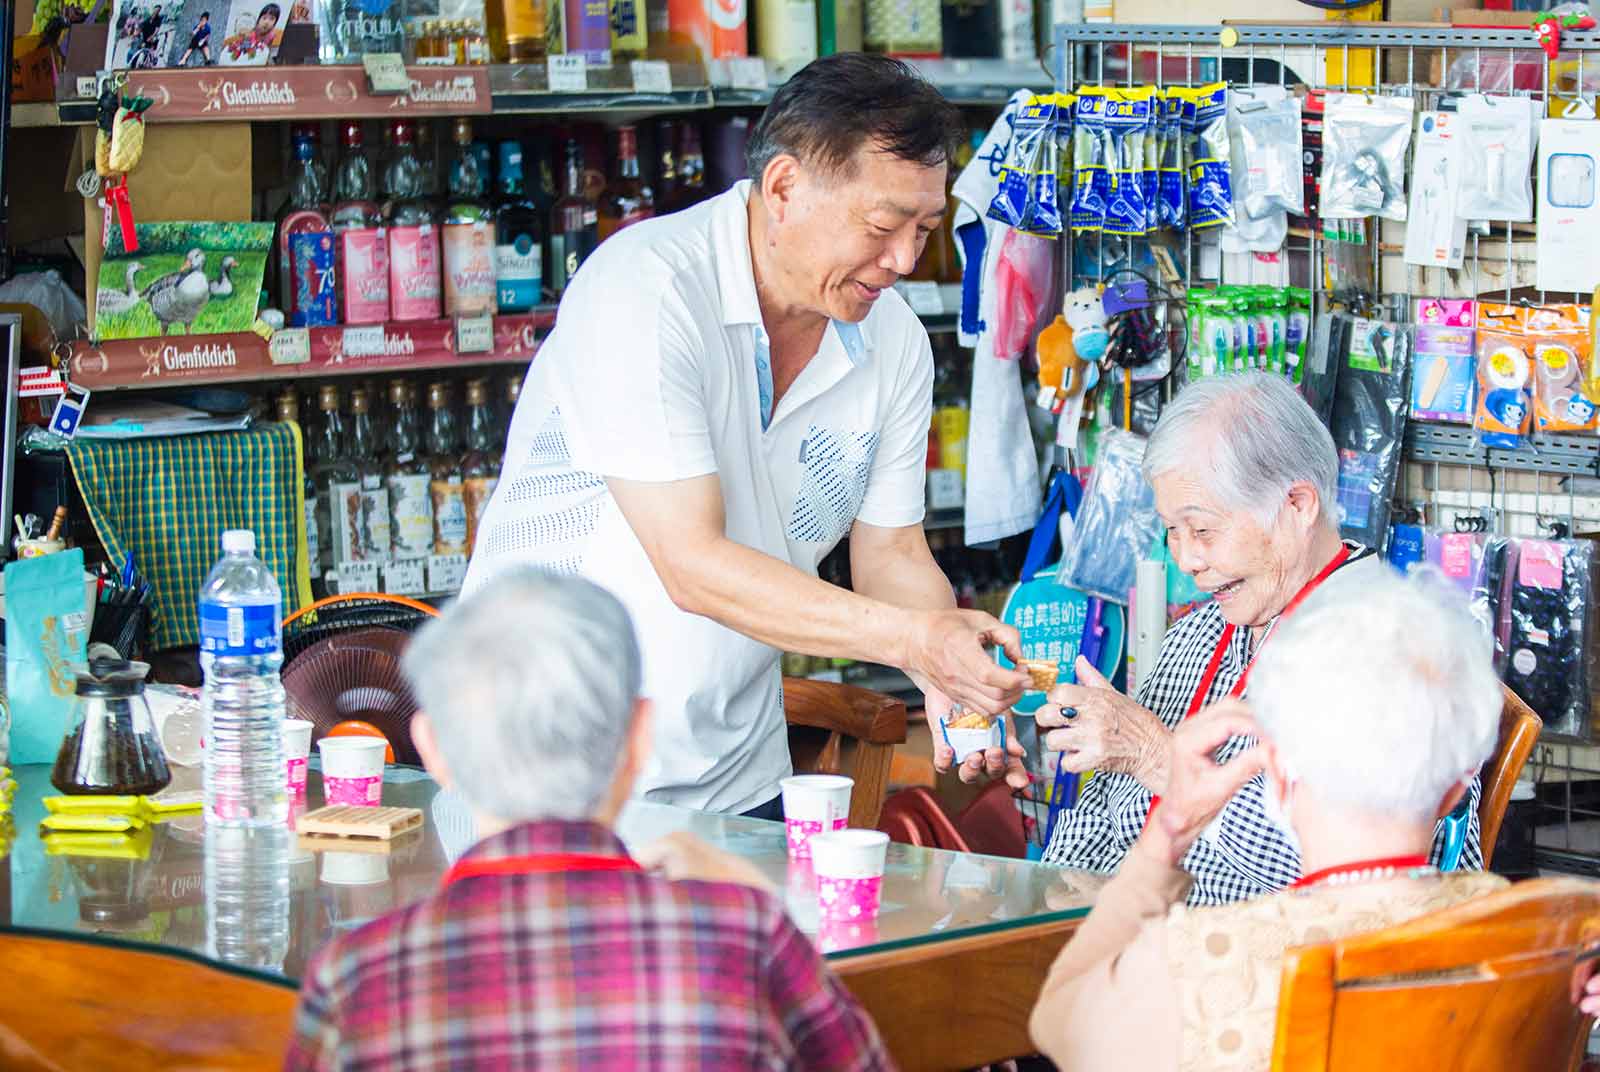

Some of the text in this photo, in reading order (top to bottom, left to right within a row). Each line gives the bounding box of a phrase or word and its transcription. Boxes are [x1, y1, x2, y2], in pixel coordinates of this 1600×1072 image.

[223, 81, 295, 105] Glenfiddich
[502, 289, 516, 305] 12
[163, 344, 237, 370] Glenfiddich
